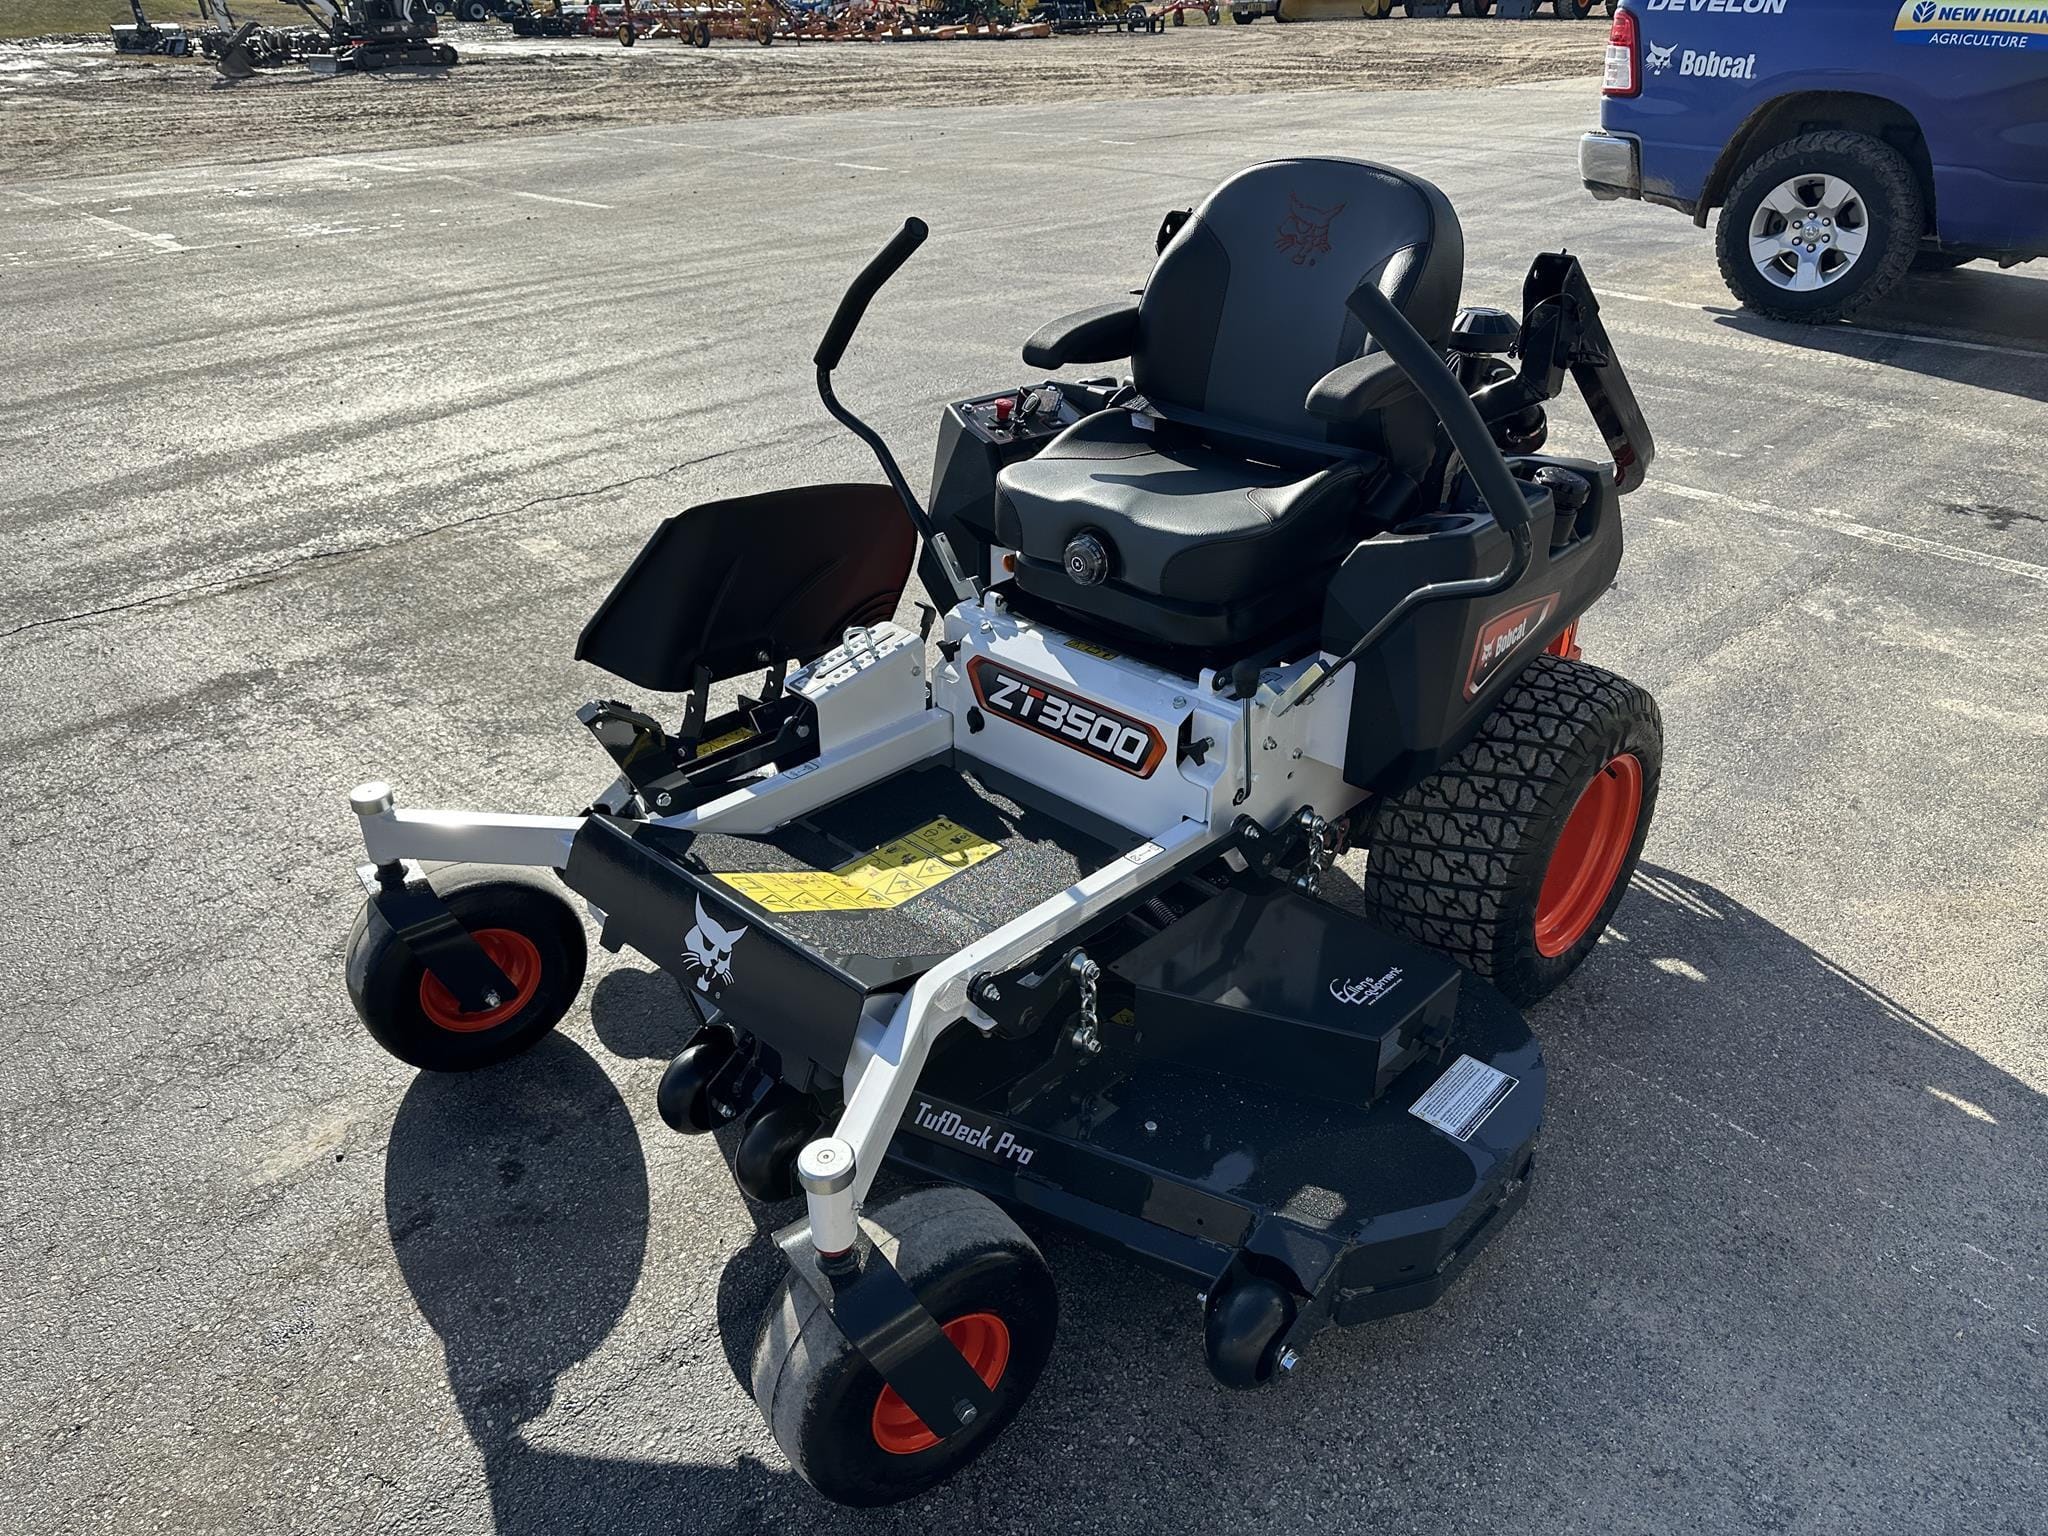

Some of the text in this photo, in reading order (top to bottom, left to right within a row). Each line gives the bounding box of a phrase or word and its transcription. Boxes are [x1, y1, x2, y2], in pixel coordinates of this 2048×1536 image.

[1647, 0, 1787, 14] DEVELON
[1938, 7, 1981, 22] NEW
[1928, 33, 2029, 48] AGRICULTURE
[1679, 50, 1756, 79] Bobcat
[1494, 617, 1527, 658] Bobcat
[989, 674, 1149, 764] ZT3500
[914, 1101, 1034, 1165] TufDeck Pro
